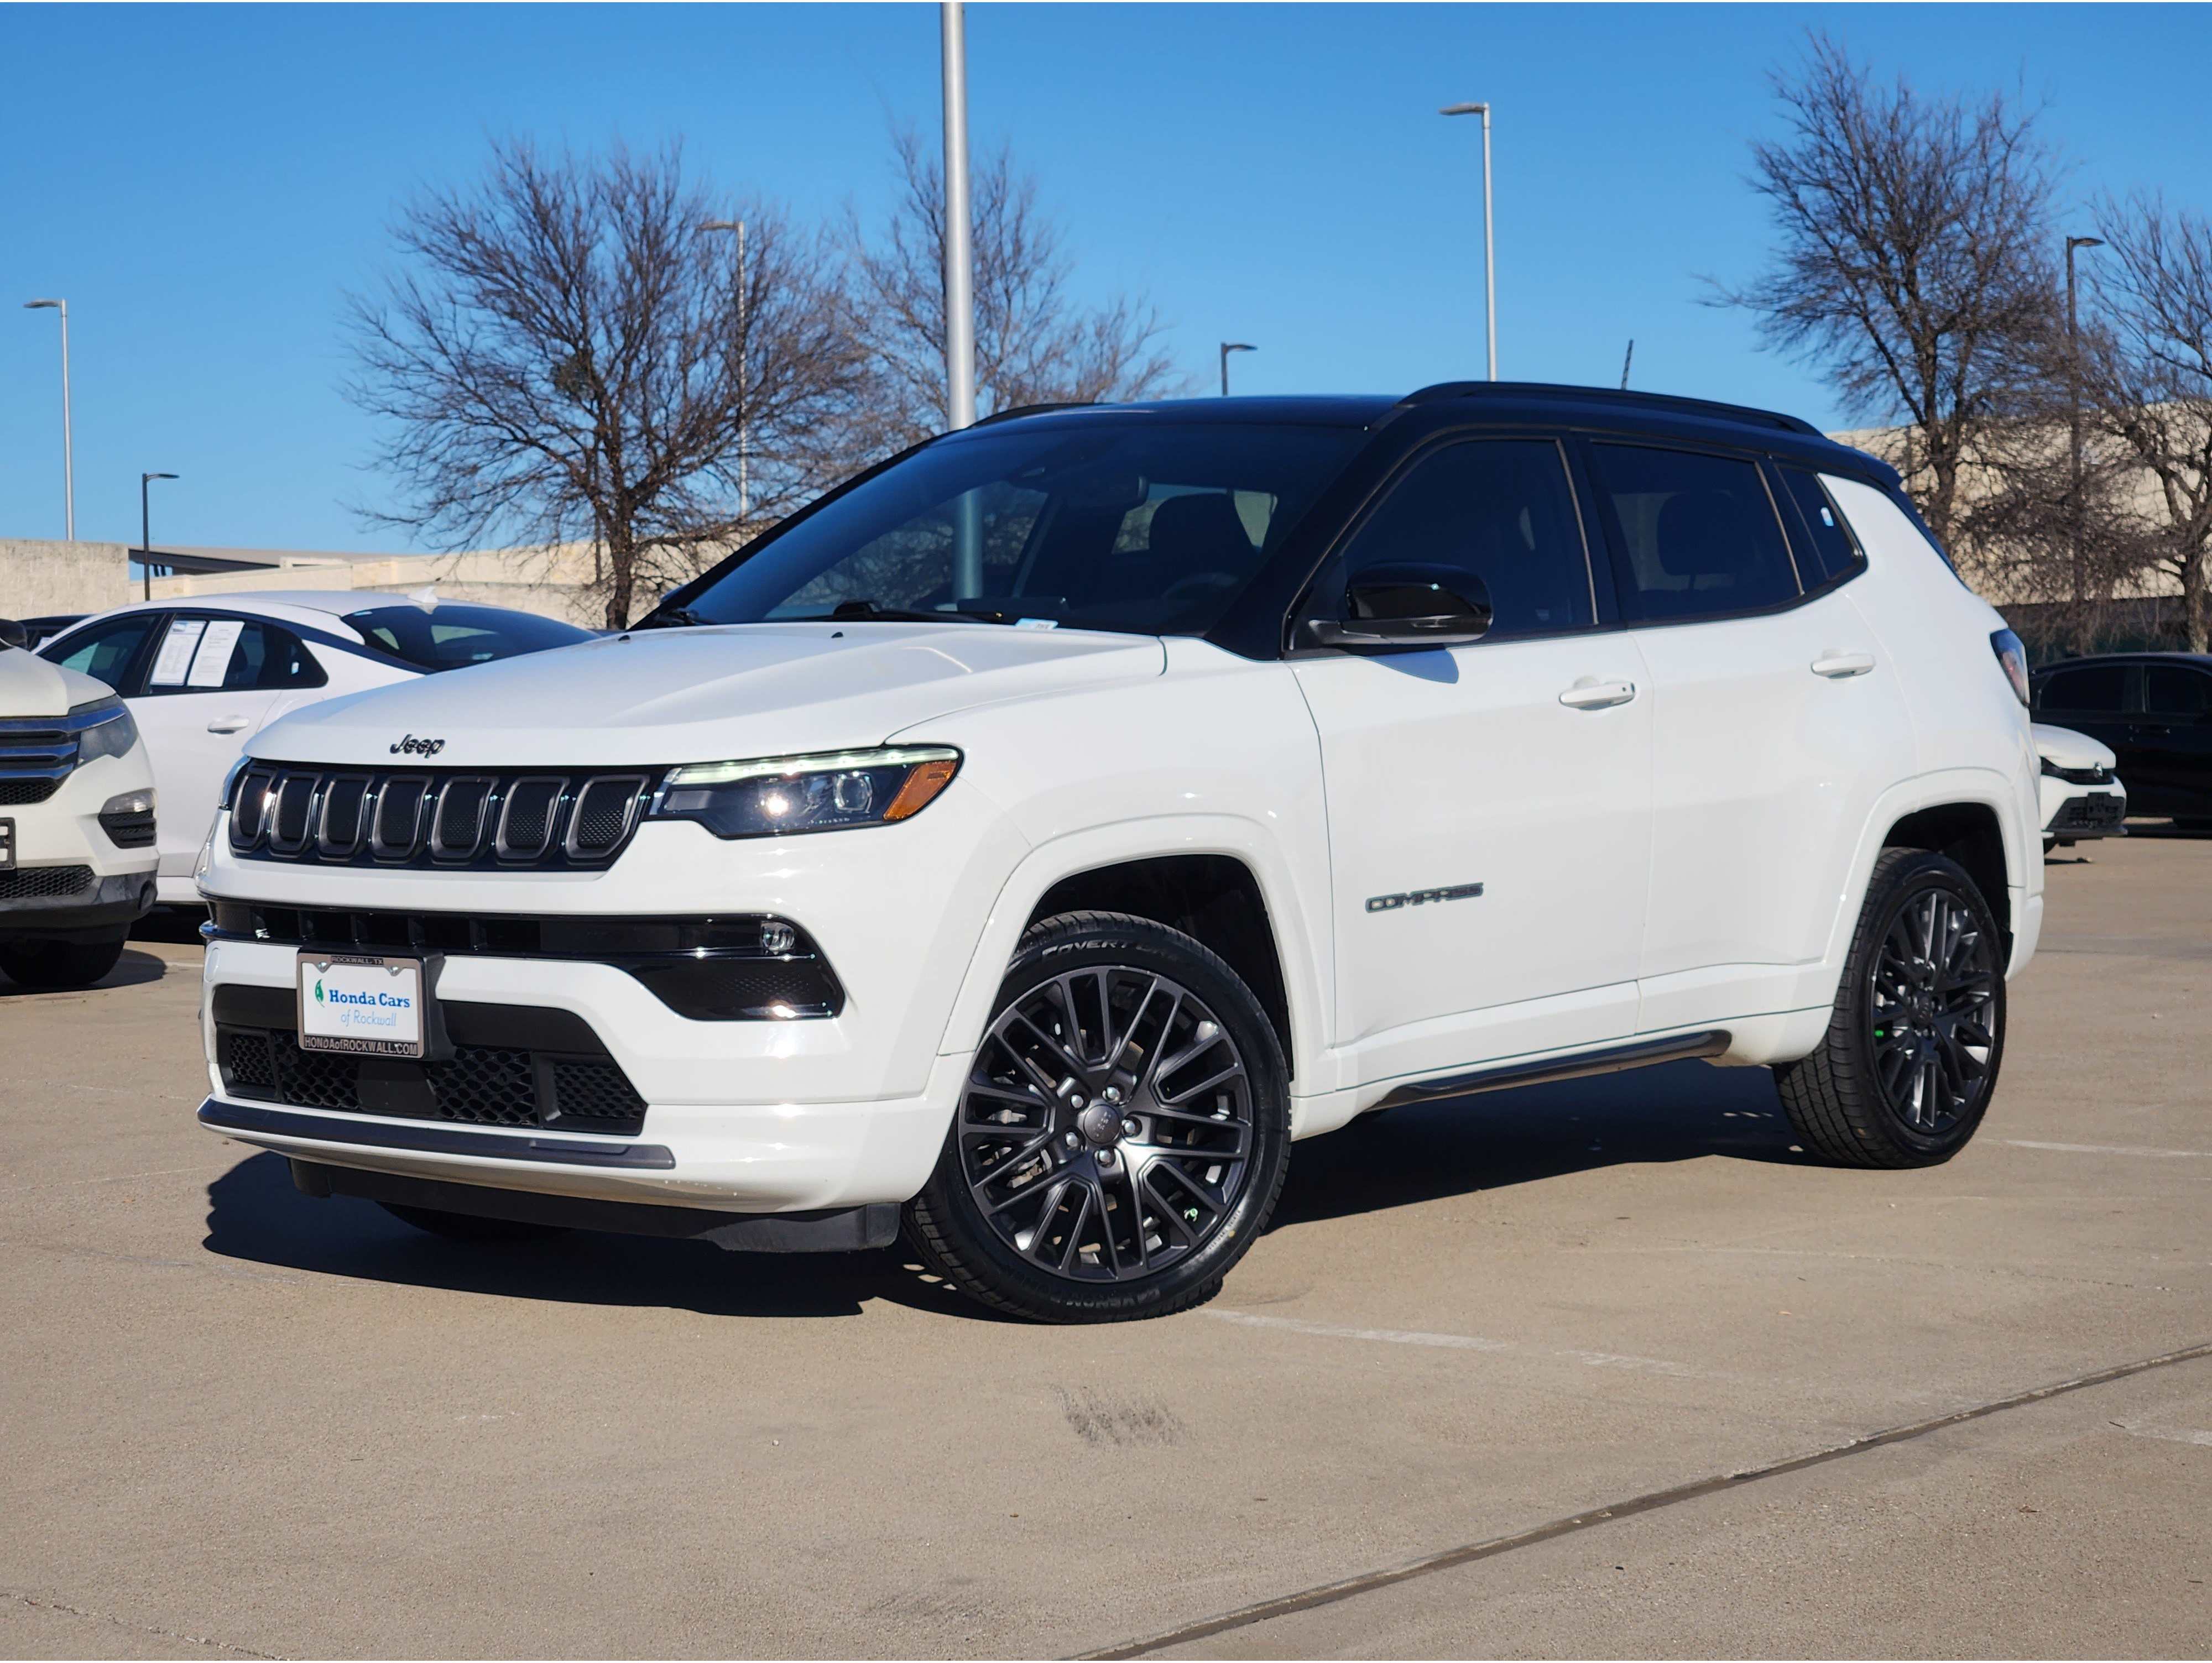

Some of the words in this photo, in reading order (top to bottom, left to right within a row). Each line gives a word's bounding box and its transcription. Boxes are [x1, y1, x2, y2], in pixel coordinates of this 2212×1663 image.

[389, 734, 445, 759] Jeep
[329, 990, 376, 1005] Honda
[379, 993, 410, 1008] Cars
[341, 1009, 351, 1027] of
[353, 1010, 397, 1027] Rockwall
[305, 1036, 418, 1055] HONDAofROCKWALL.COM
